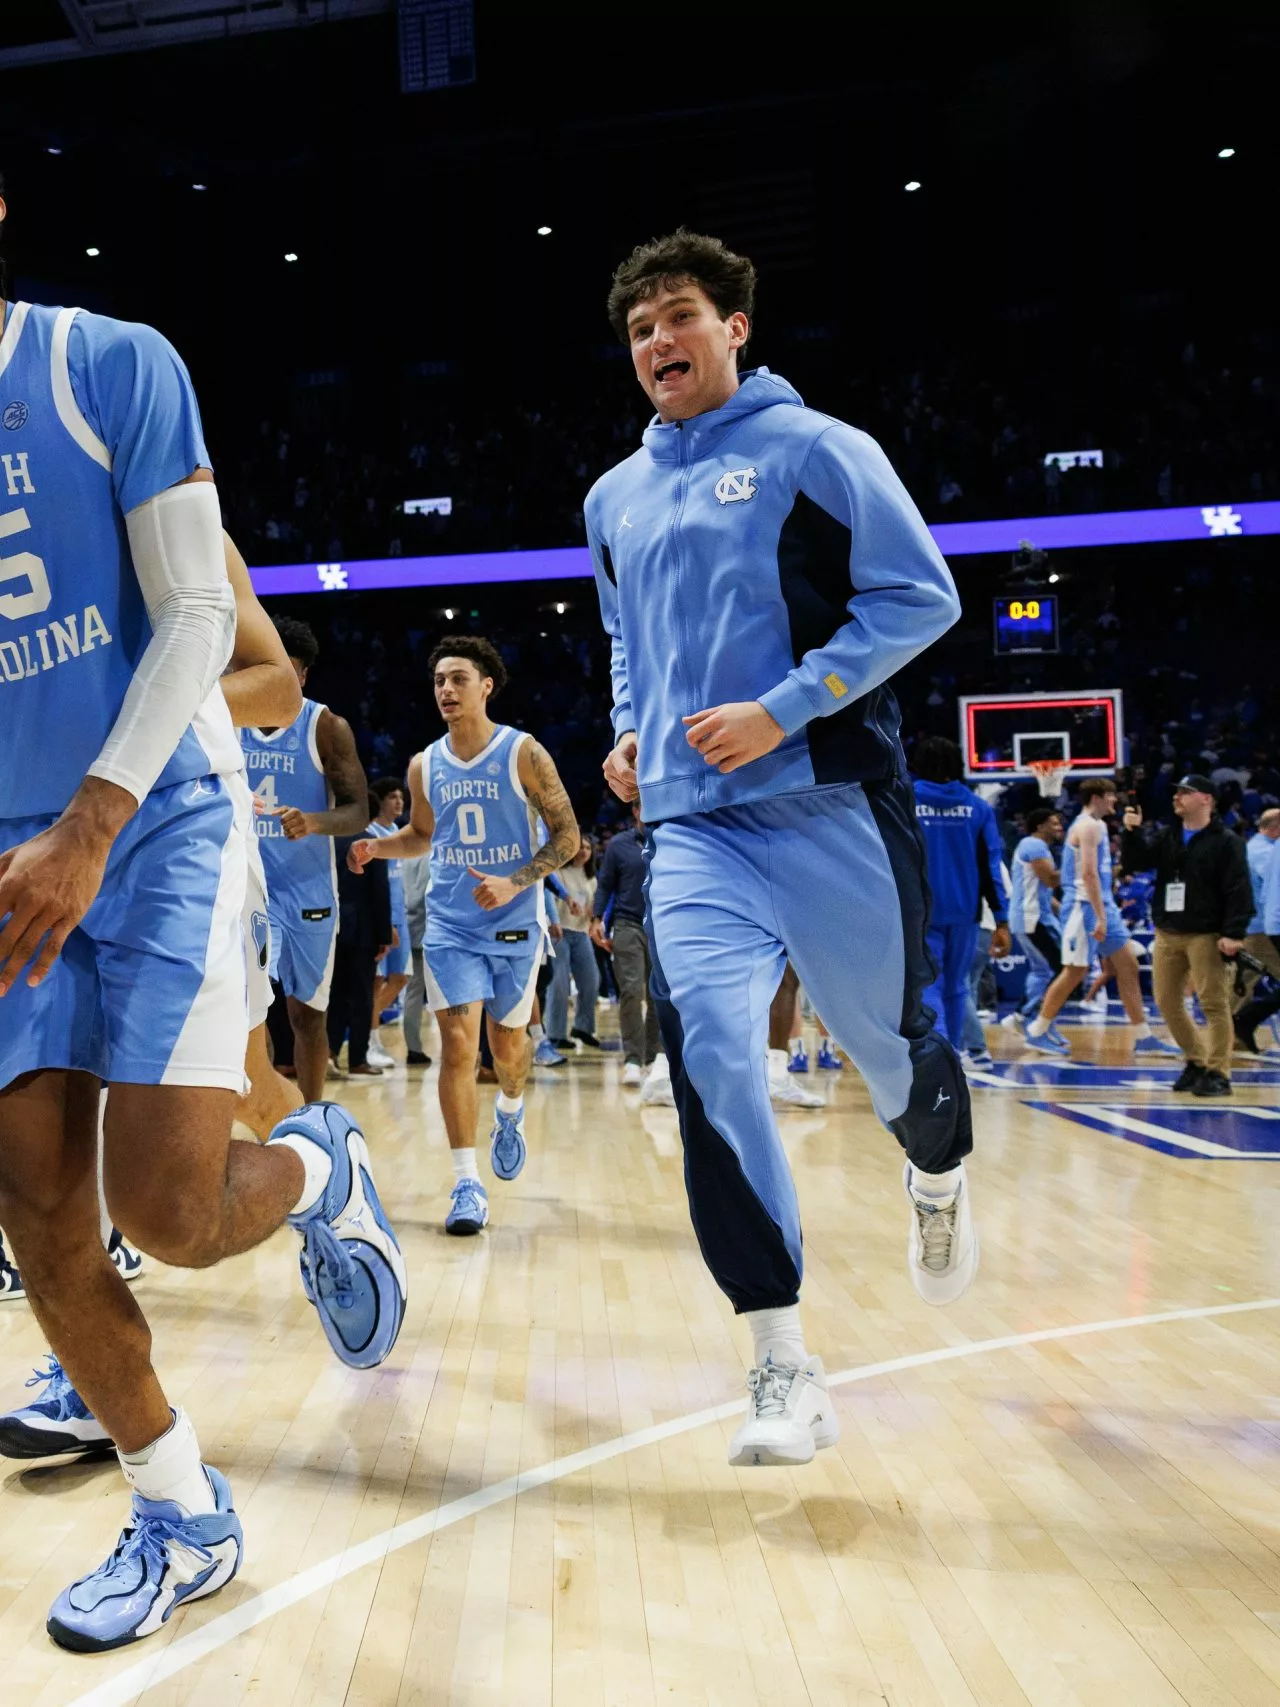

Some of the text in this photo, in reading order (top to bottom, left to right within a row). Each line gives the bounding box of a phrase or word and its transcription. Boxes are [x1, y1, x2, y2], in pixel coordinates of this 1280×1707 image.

[255, 775, 279, 815] 4
[440, 779, 499, 804] NORTH
[456, 803, 487, 845] 0
